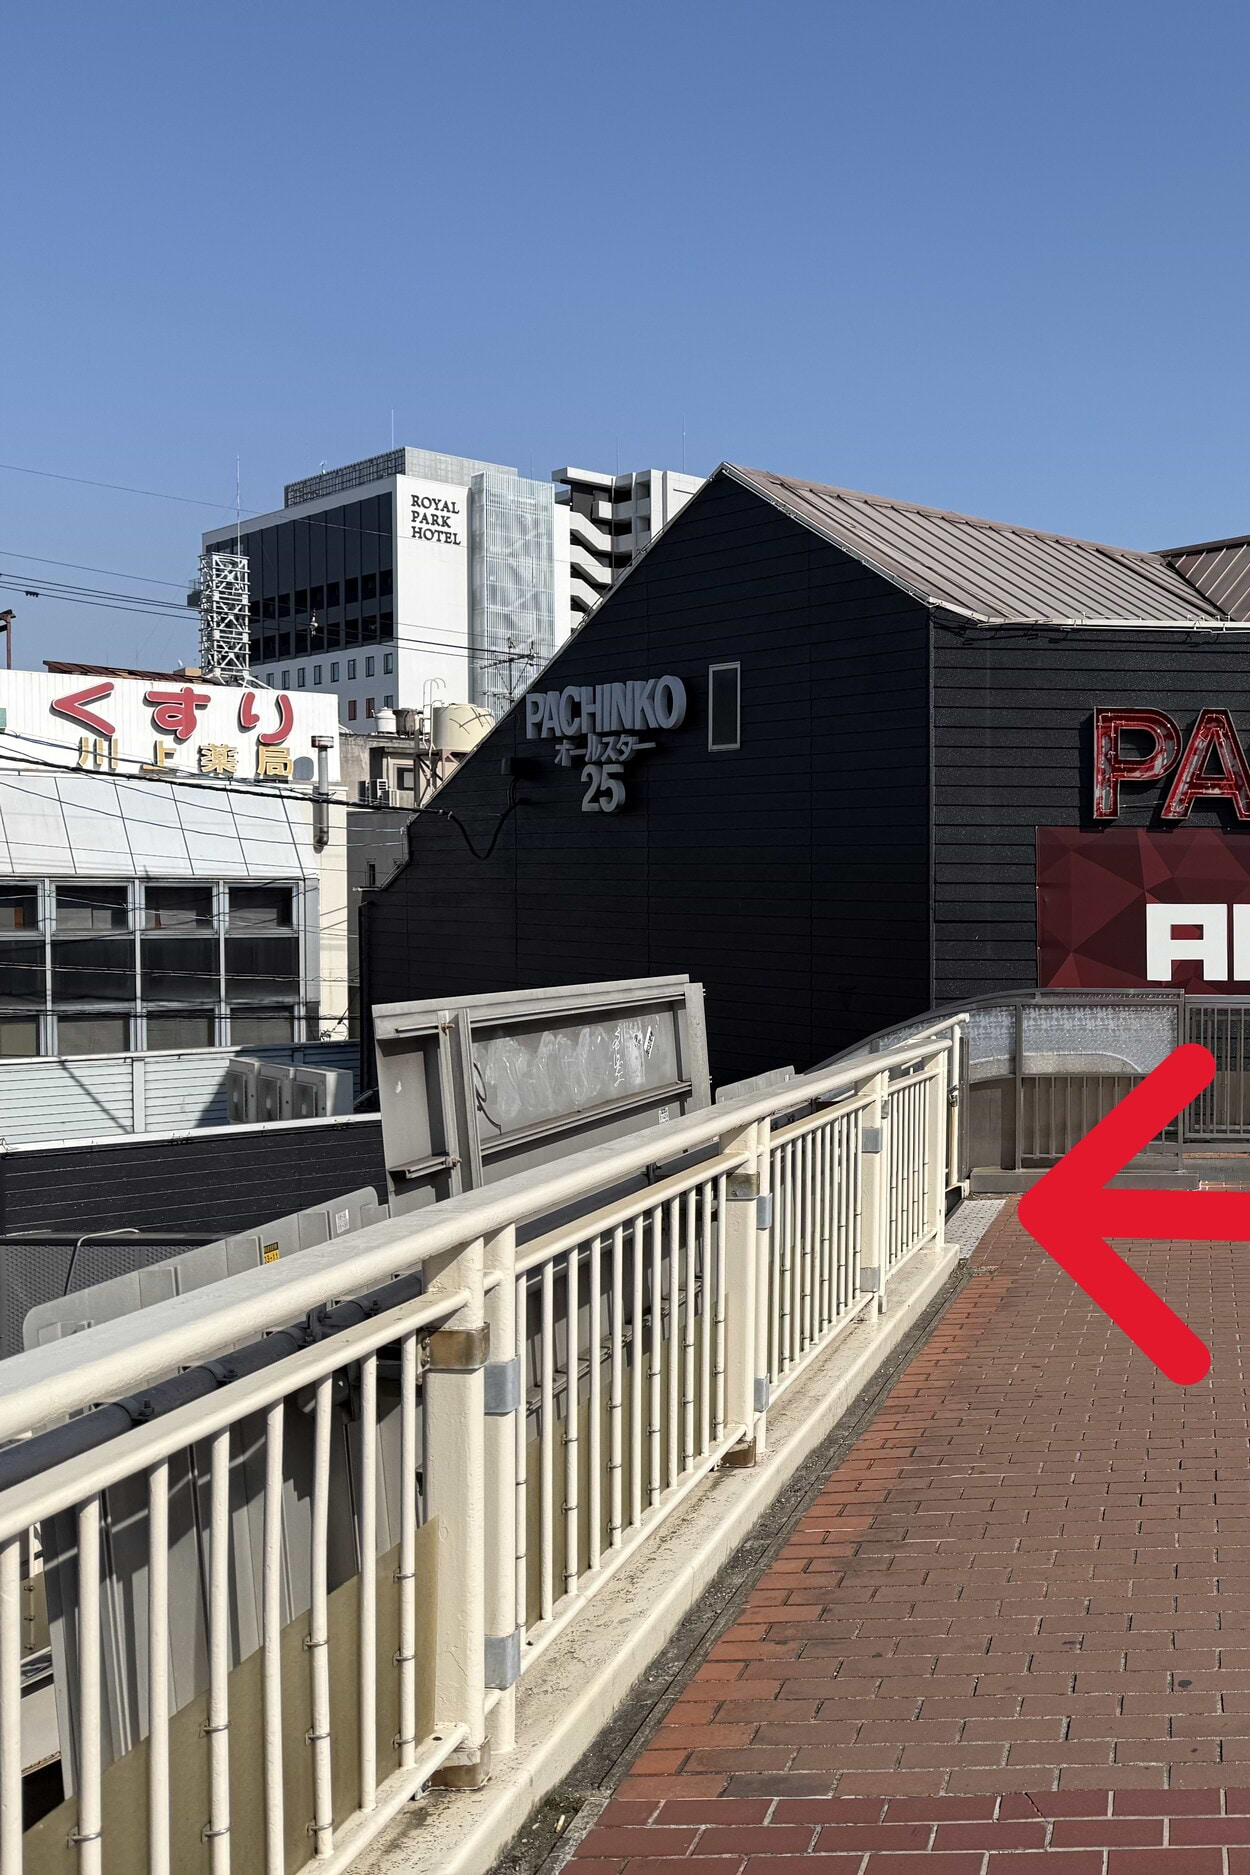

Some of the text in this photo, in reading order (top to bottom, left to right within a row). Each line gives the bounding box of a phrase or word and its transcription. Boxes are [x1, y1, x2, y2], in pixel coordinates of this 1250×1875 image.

[411, 494, 460, 515] ROYAL
[411, 510, 451, 528] PARK
[411, 526, 461, 545] HOTEL
[51, 681, 294, 744] くすり
[525, 675, 687, 739] PACHINKO
[79, 737, 294, 777] 川上薬局
[554, 733, 657, 767] オールスター
[580, 764, 626, 813] 25
